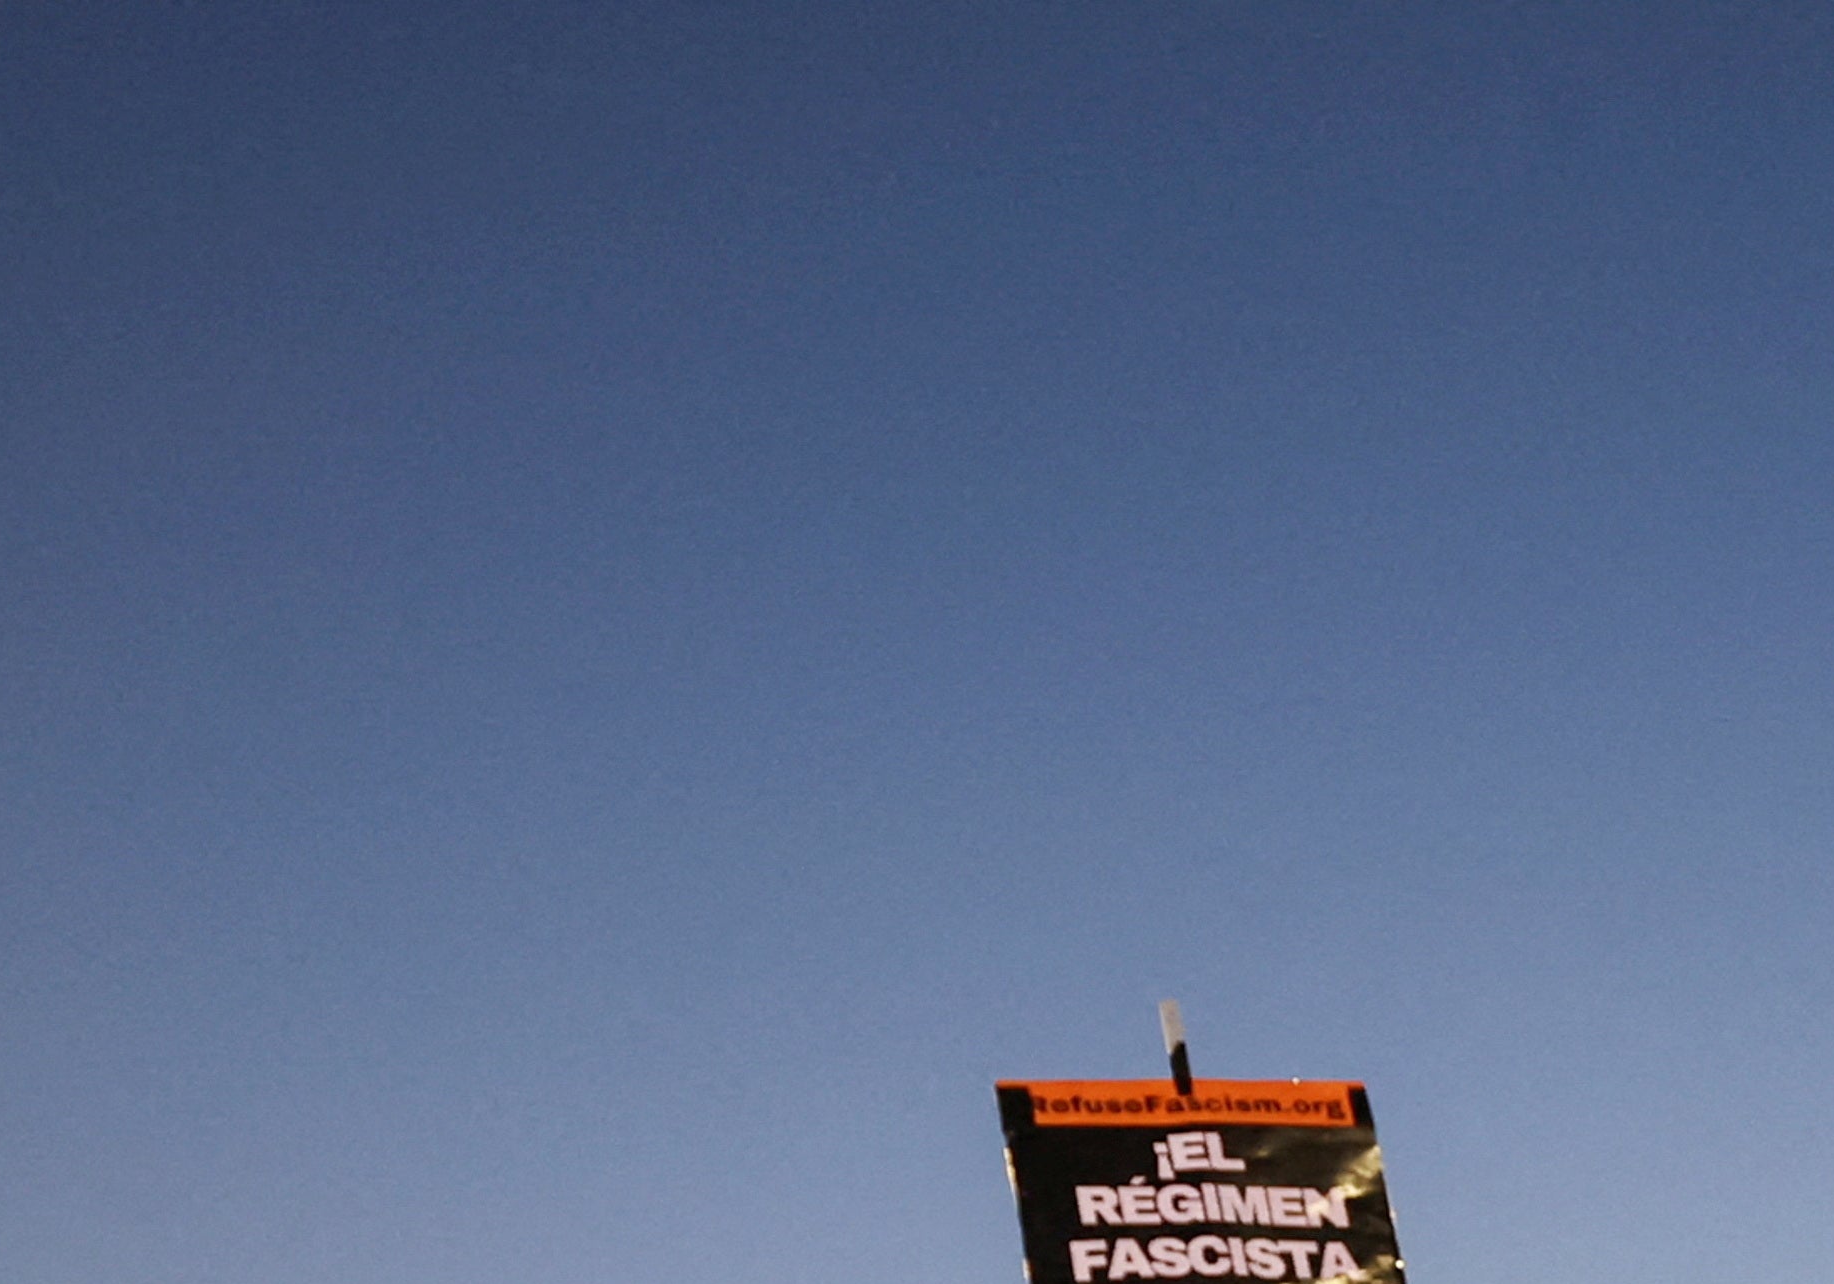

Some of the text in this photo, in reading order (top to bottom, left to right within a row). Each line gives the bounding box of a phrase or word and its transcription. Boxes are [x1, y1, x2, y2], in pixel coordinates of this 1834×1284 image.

[1153, 1131, 1246, 1180] ¡EL
[1075, 1176, 1349, 1228] RÉGIMEN
[1069, 1234, 1365, 1283] FASCISTA
